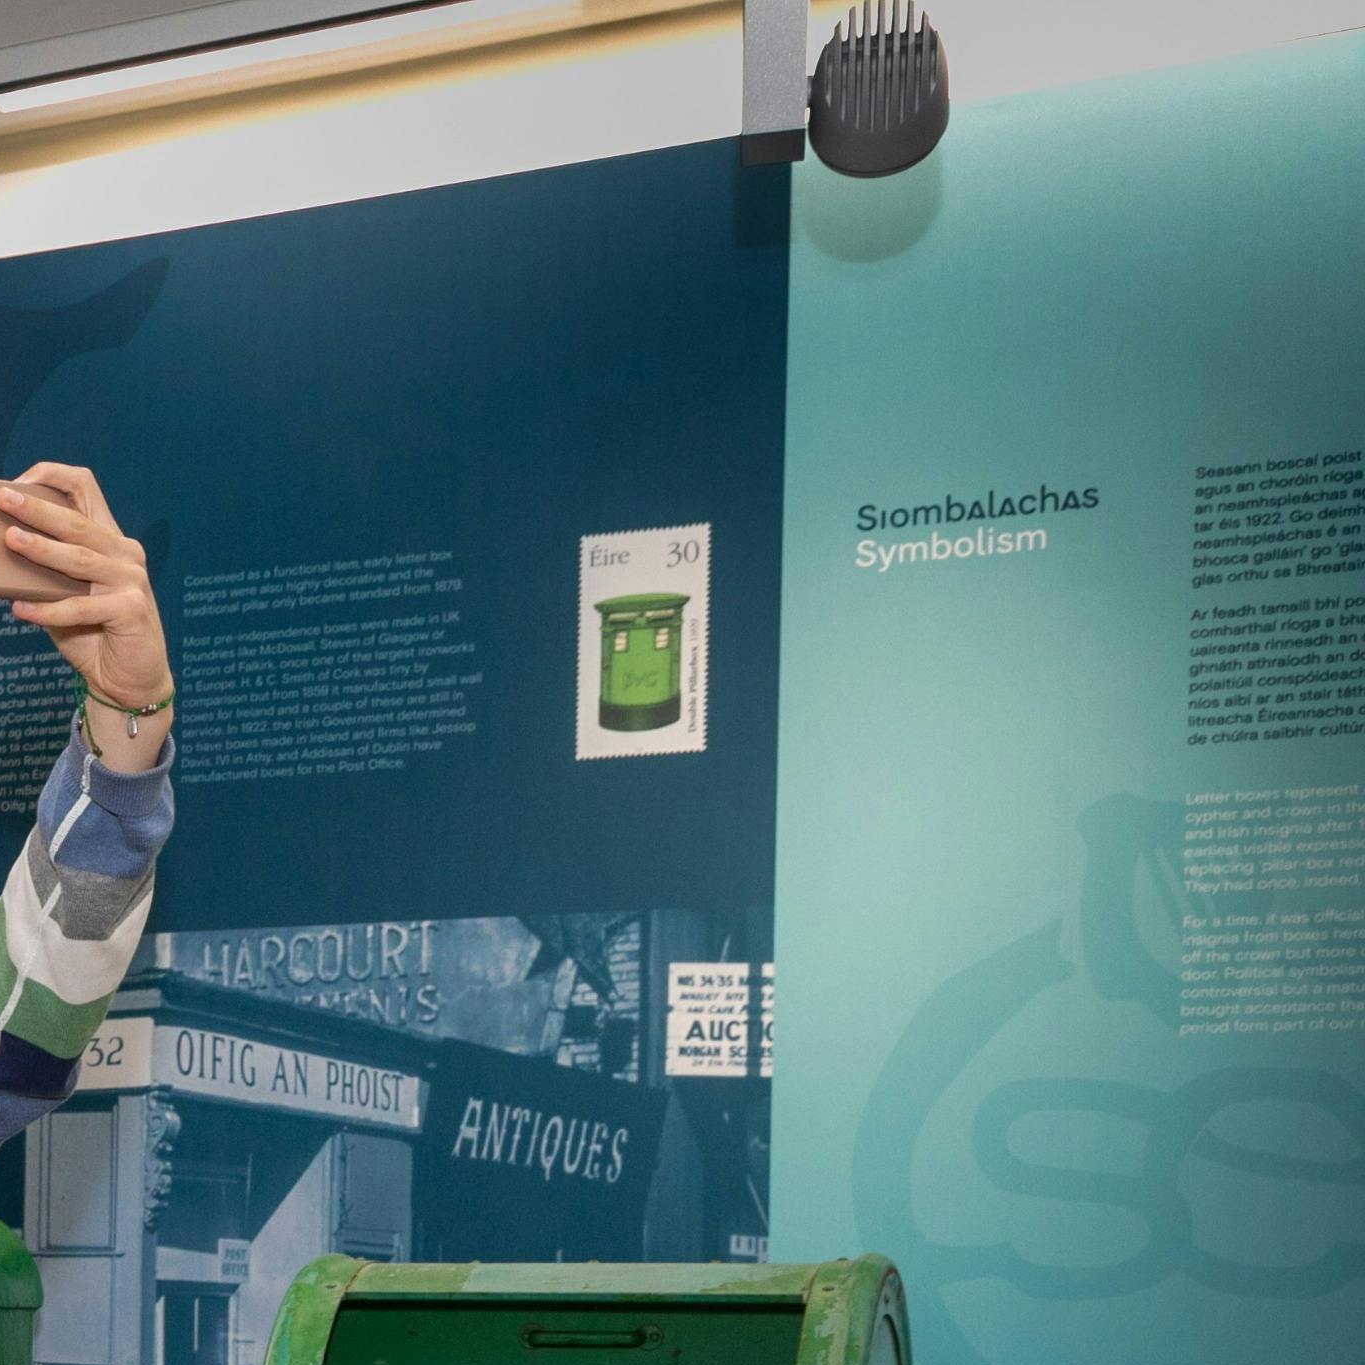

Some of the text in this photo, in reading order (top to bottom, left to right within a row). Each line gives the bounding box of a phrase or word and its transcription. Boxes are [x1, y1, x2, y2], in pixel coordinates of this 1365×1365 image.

[1195, 450, 1361, 479] Seasann boscaí poist
[1195, 469, 1363, 498] agus an choróin ríoga
[1195, 488, 1347, 514] an neamhspleáchas
[1194, 520, 1214, 532] tar
[1218, 517, 1240, 529] éis
[1289, 510, 1312, 522] Go
[1326, 523, 1337, 537] é
[1342, 524, 1361, 535] an
[589, 539, 700, 568] Éire 30
[854, 526, 1047, 572] Symbolism
[1193, 553, 1248, 568] bhosca
[1310, 545, 1331, 559] go
[183, 570, 244, 586] Conceived
[247, 570, 260, 580] as
[263, 569, 270, 578] a
[273, 561, 331, 577] functional
[363, 554, 393, 568] early
[395, 552, 426, 564] letter
[430, 550, 452, 561] box
[1191, 567, 1291, 589] glas orthu sa
[183, 566, 434, 602] designs were also highly decorative and the
[183, 600, 239, 617] traditional
[271, 596, 296, 608] only
[298, 592, 346, 606] became
[349, 584, 400, 600] standard
[403, 583, 430, 594] from
[1190, 608, 1208, 621] Ar
[1212, 604, 1256, 619] feadh
[1315, 594, 1341, 610] bhí
[1325, 617, 1334, 627] a
[1189, 633, 1357, 656] uaireanta rinneadh an
[1189, 659, 1242, 677] ghnáth
[1325, 652, 1344, 663] an
[1188, 697, 1219, 709] níos
[1256, 694, 1270, 704] ar
[1275, 692, 1294, 703] an
[1299, 687, 1332, 701] stair
[1187, 705, 1353, 727] litreacha Éireannacha
[1187, 732, 1207, 745] de
[1263, 724, 1315, 740] saibhir
[203, 920, 439, 990] HARCOURT
[176, 1029, 404, 1112] OIFIG AN PHOIST
[451, 1096, 628, 1182] ANTIQUES
